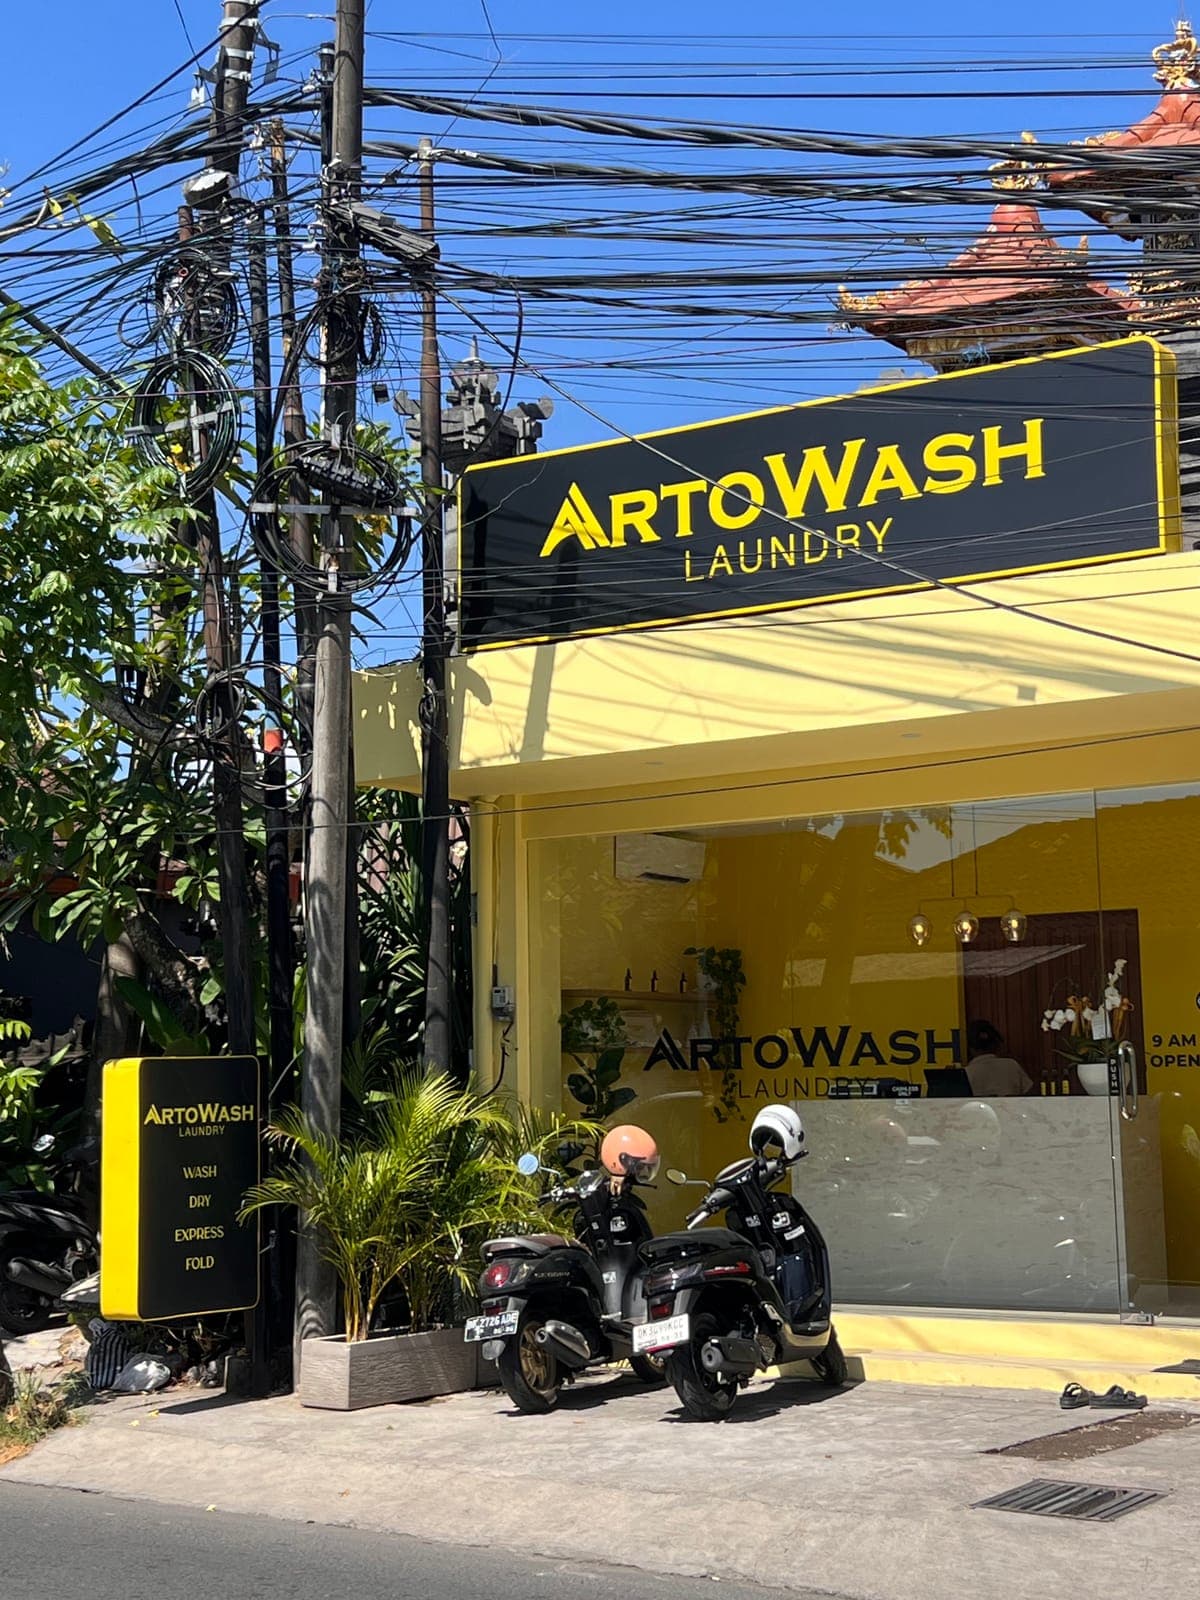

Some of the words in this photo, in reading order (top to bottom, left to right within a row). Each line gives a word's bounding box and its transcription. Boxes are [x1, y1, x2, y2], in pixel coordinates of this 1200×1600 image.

[540, 418, 1046, 557] ARTOWASH
[685, 517, 894, 582] LAUNDRY
[644, 1025, 960, 1071] ARTOWASH
[1151, 1034, 1163, 1047] 9
[1168, 1034, 1196, 1046] AM
[1150, 1054, 1200, 1068] OPEN
[144, 1103, 254, 1125] ARTOWASH
[179, 1125, 225, 1137] LAUNDRY
[183, 1165, 217, 1179] WASH
[189, 1195, 211, 1208] DRY
[174, 1226, 225, 1242] EXPRESS
[185, 1256, 215, 1271] FOLD
